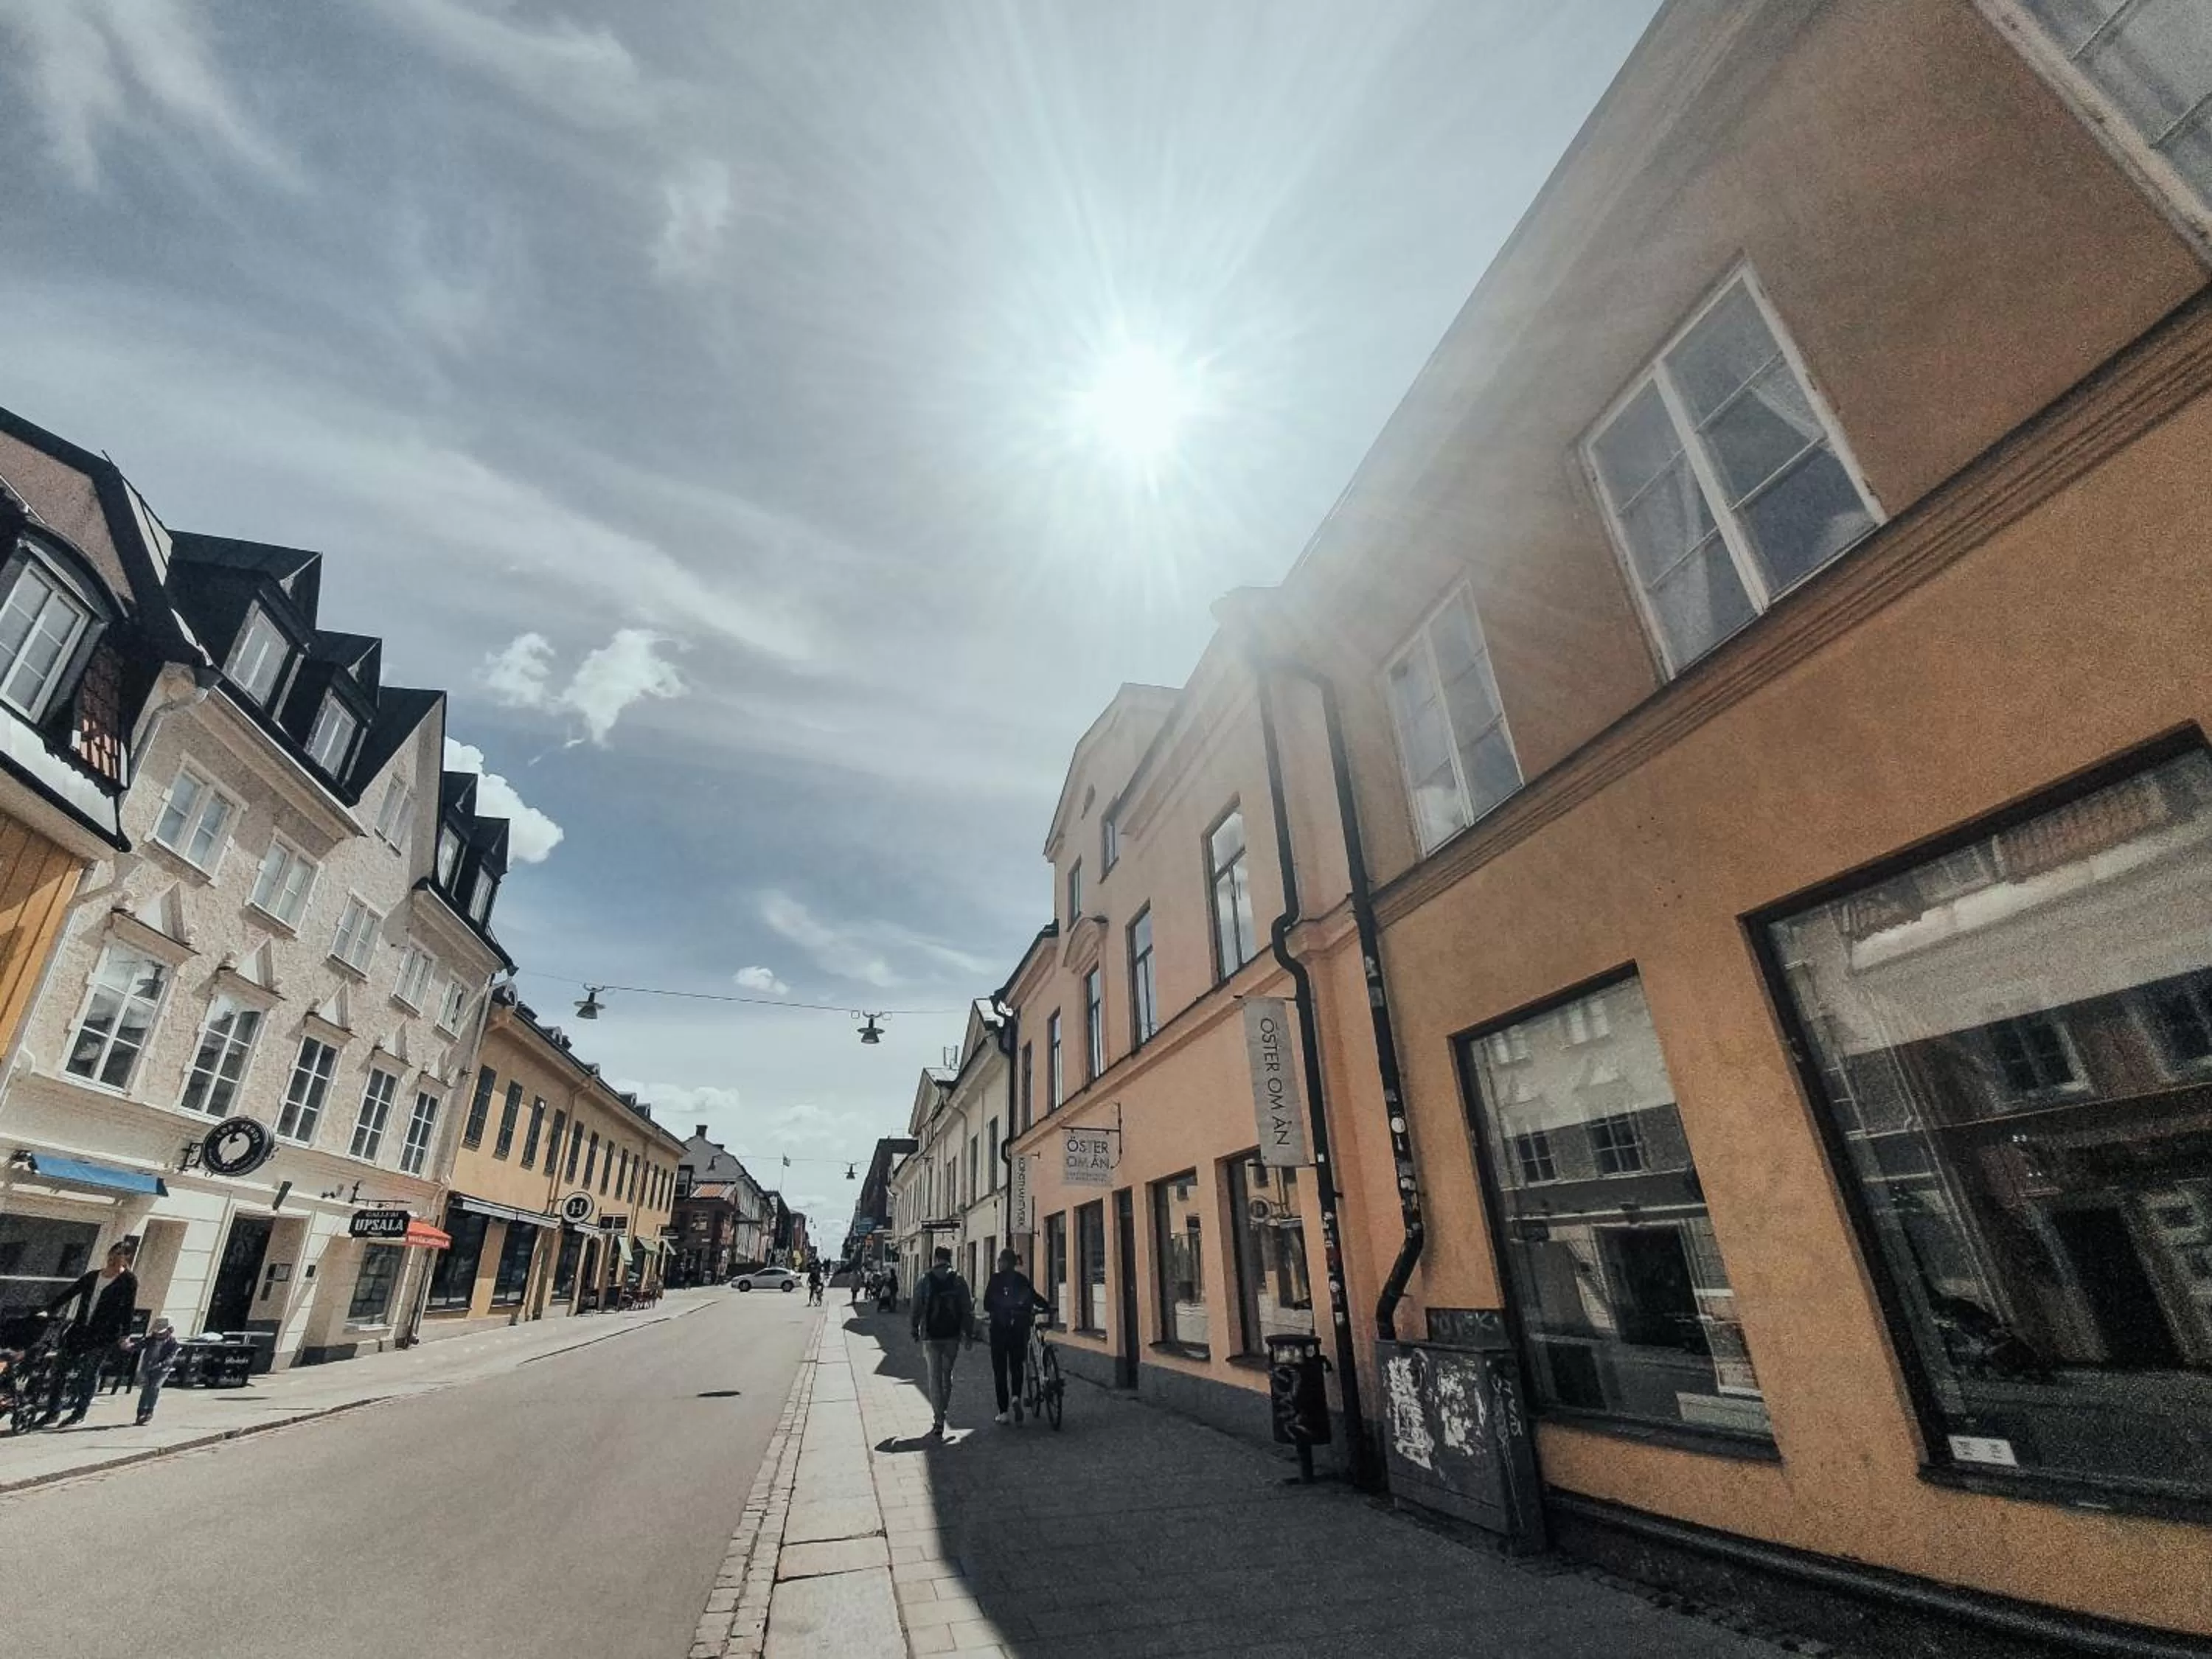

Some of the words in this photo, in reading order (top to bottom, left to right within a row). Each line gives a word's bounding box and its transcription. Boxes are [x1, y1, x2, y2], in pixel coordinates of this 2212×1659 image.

[1260, 1018, 1281, 1072] ÖSTER
[1267, 1077, 1286, 1110] OM
[1272, 1116, 1293, 1146] ÅN
[1067, 1136, 1109, 1154] ÖSTER
[1066, 1155, 1088, 1167] OM
[1091, 1155, 1110, 1169] ÅN
[570, 1201, 584, 1215] H
[355, 1219, 404, 1231] UPSALA
